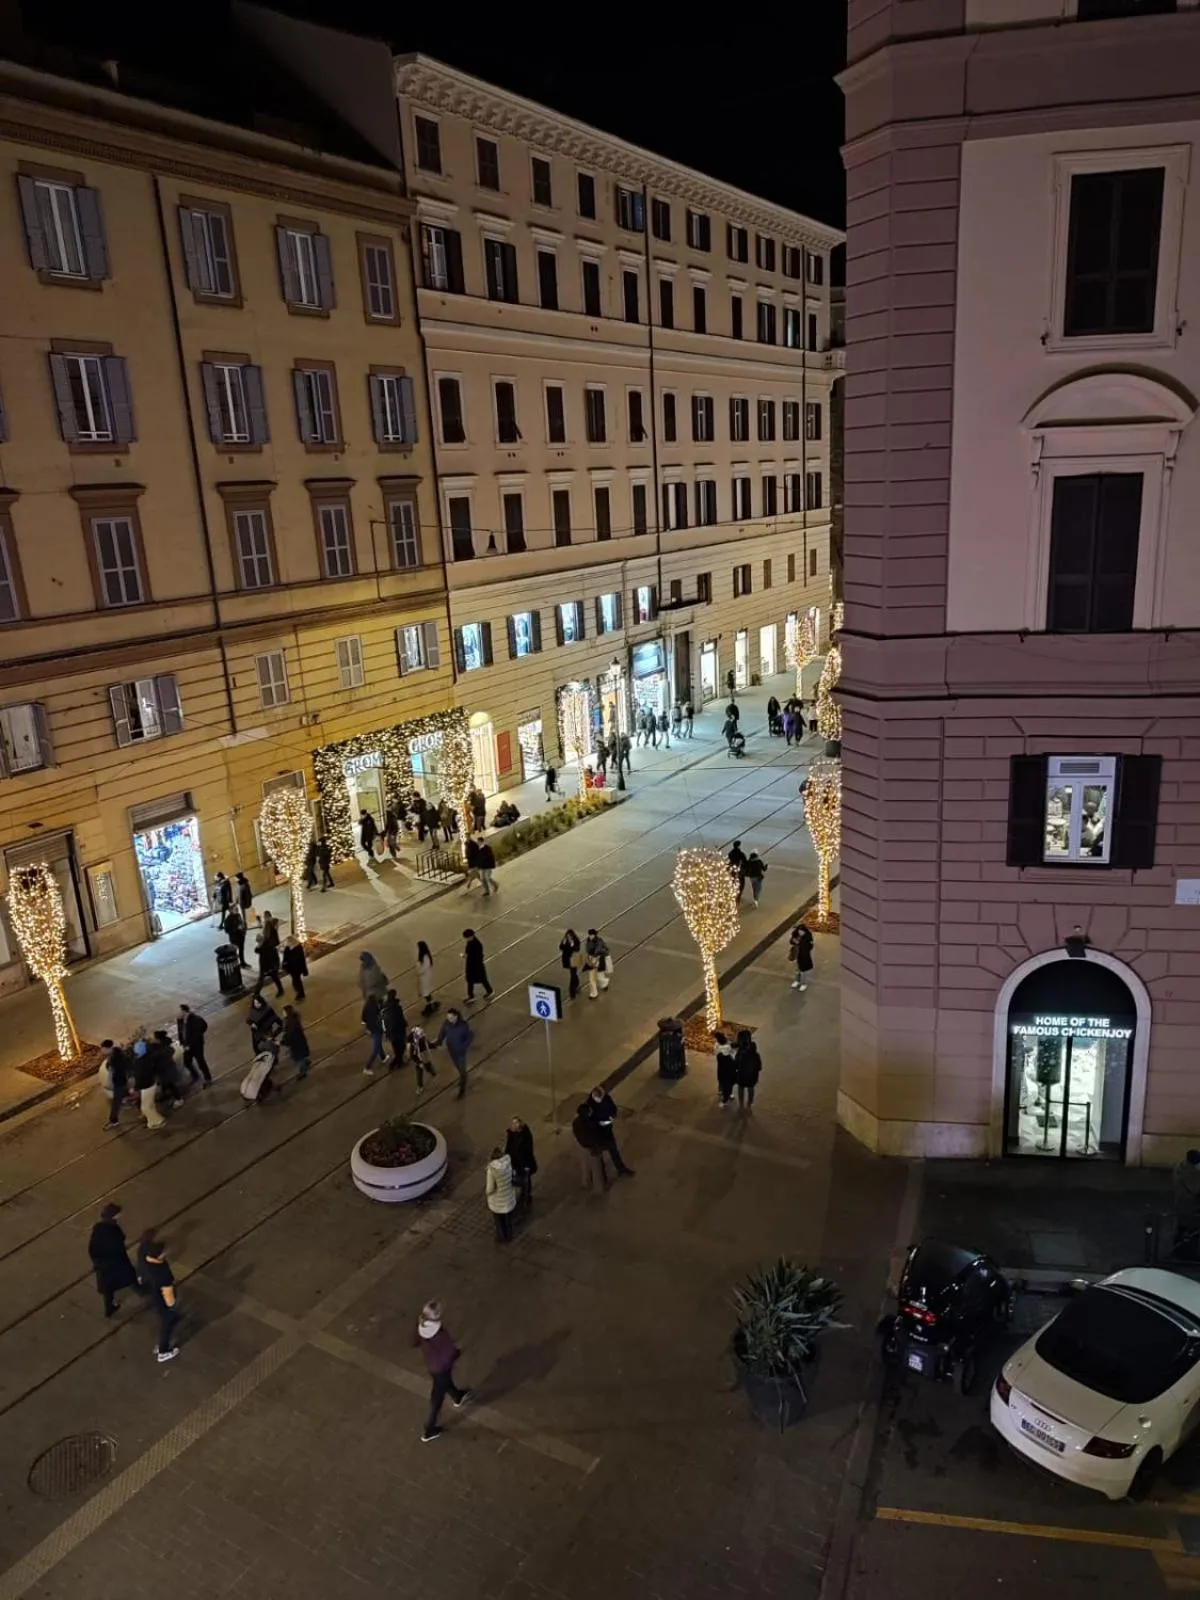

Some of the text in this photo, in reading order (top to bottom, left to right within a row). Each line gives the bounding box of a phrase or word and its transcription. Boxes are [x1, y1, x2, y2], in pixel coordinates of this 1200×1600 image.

[343, 752, 384, 777] GROM
[1035, 1016, 1110, 1028] HOME OF THE
[1012, 1026, 1132, 1039] FAMOUS CHICKENJOY
